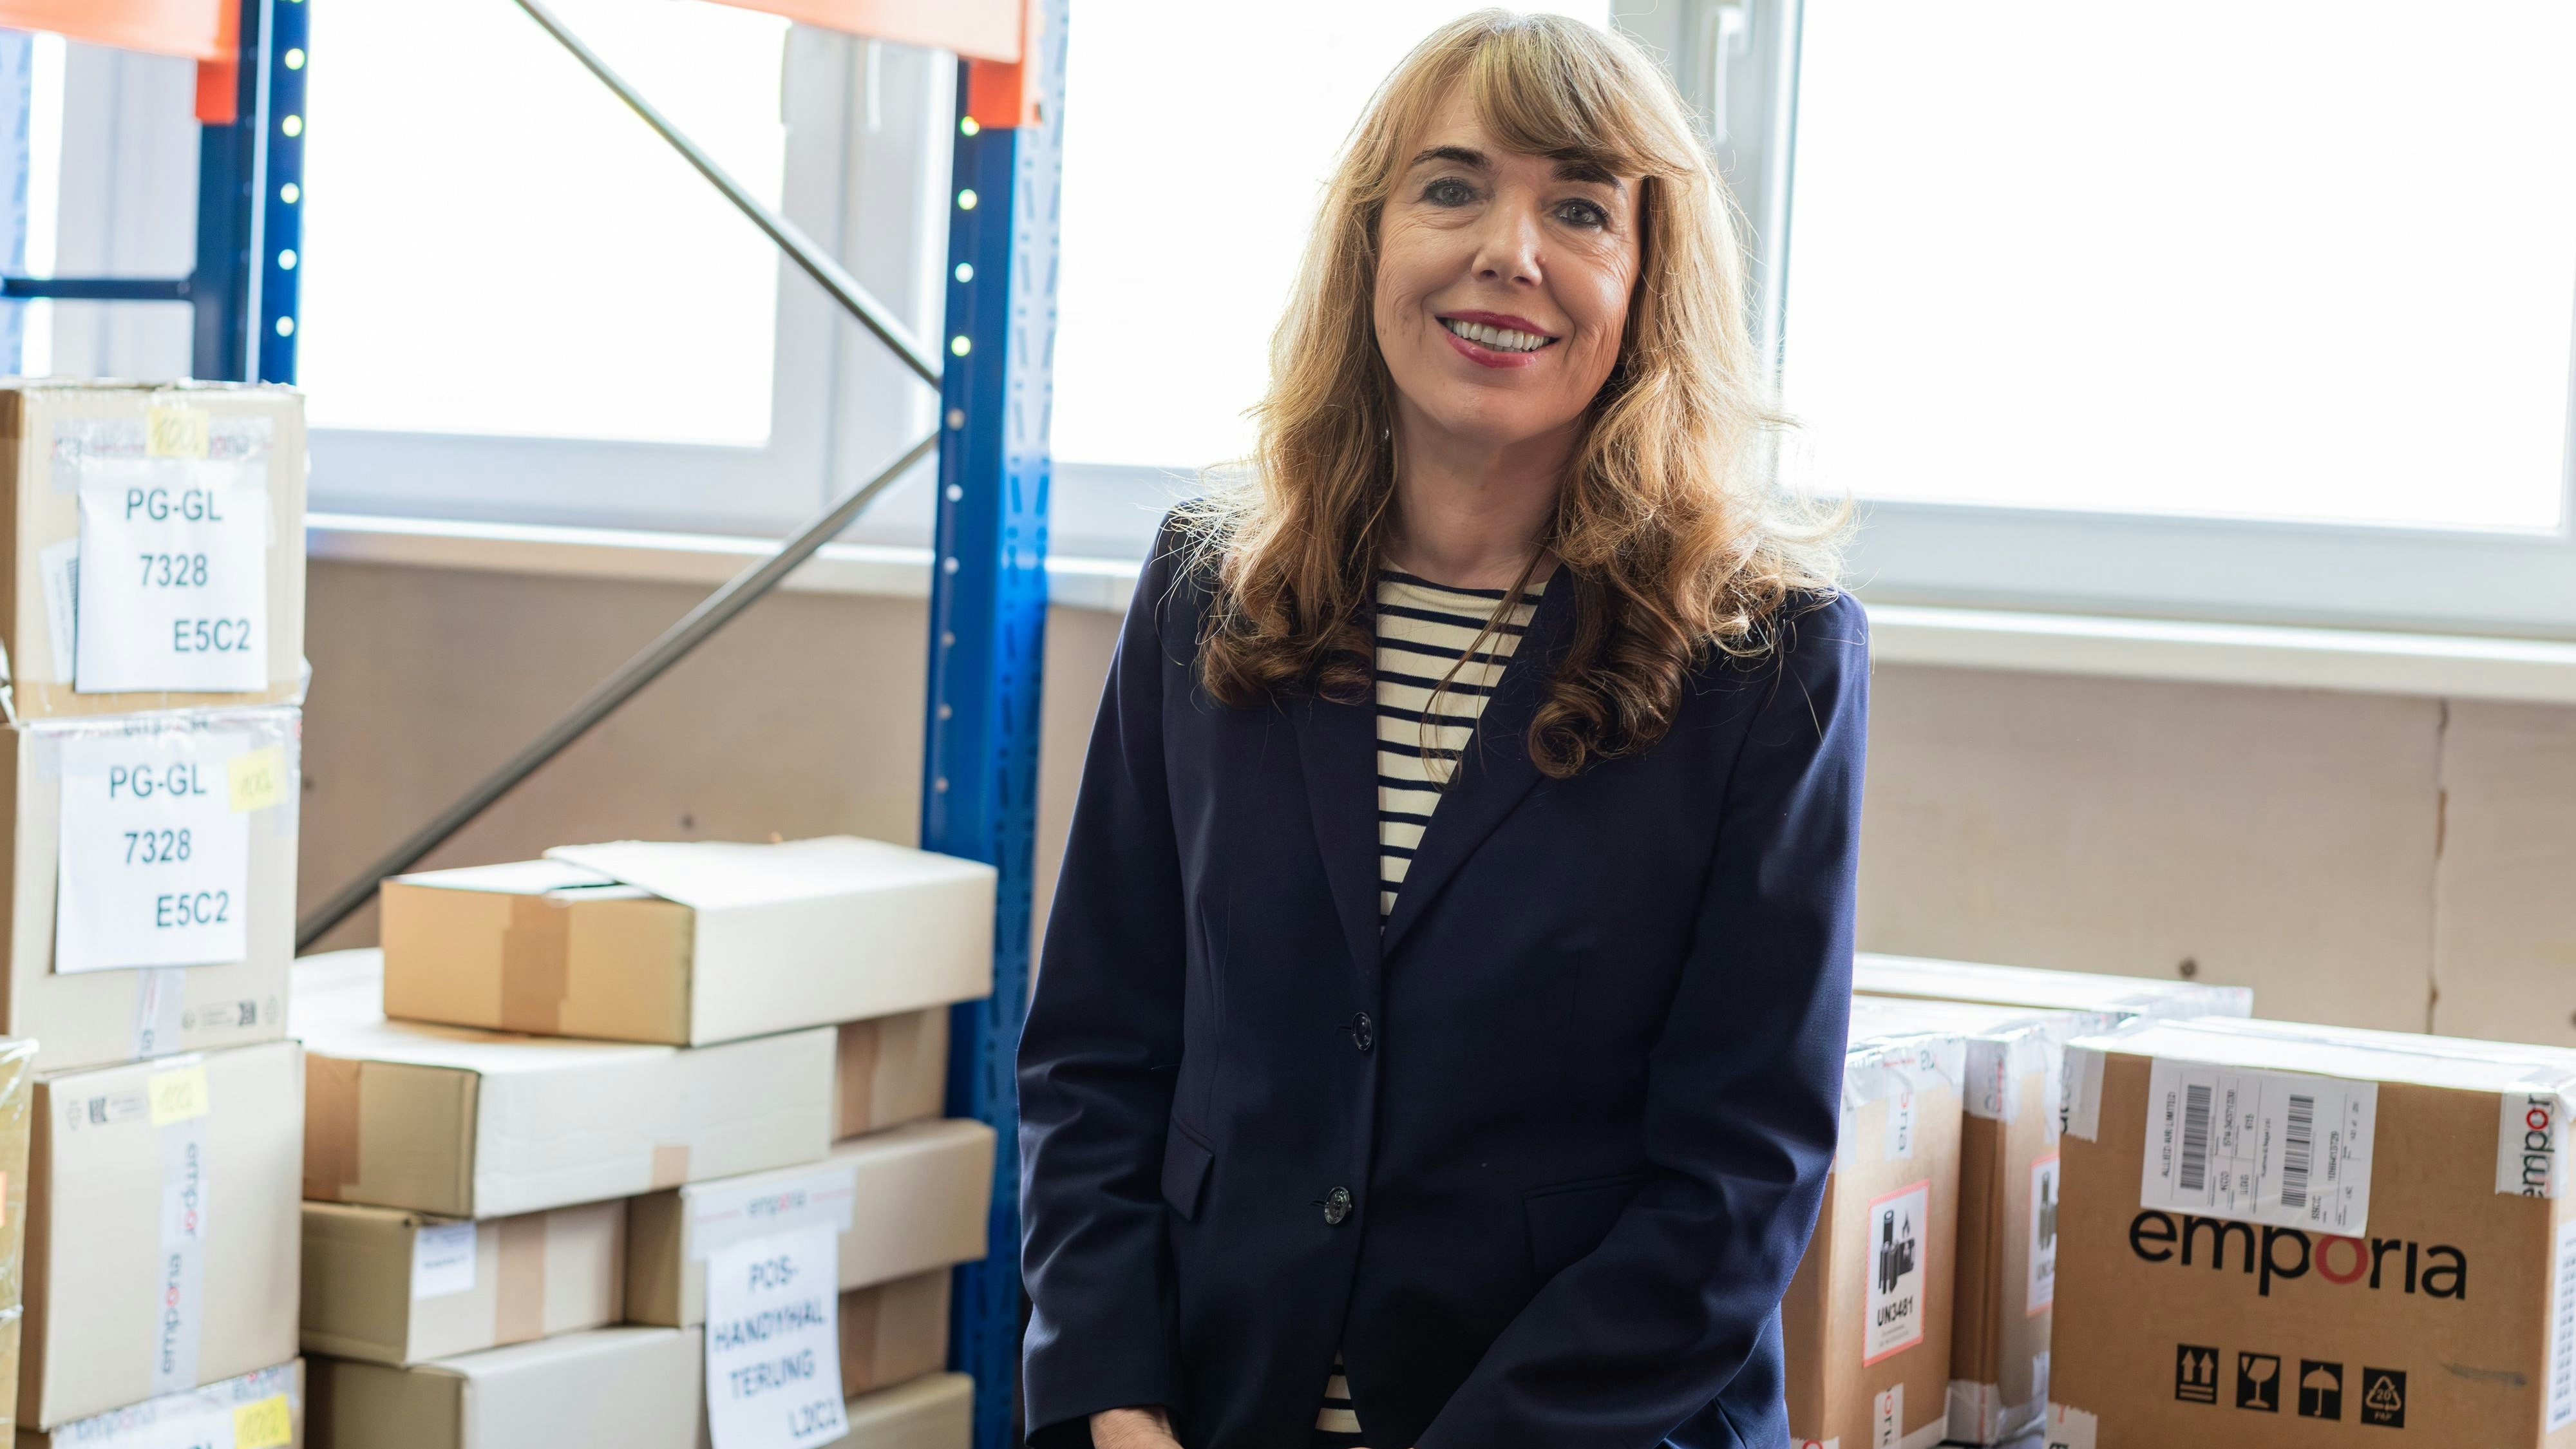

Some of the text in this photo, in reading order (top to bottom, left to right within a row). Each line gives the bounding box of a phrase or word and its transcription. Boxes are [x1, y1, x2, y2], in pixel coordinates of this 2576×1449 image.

[126, 488, 223, 521] PG-GL
[140, 554, 209, 587] 7328
[174, 618, 251, 652] E5C2
[109, 762, 207, 799] PG-GL
[124, 829, 192, 864] 7328
[156, 891, 230, 929] E5C2
[2128, 1209, 2467, 1300] emporia
[162, 1253, 183, 1374] emporia
[714, 1300, 825, 1350] HANDYHAL
[1877, 1295, 1913, 1327] UN3481
[729, 1350, 815, 1397] TERUNG
